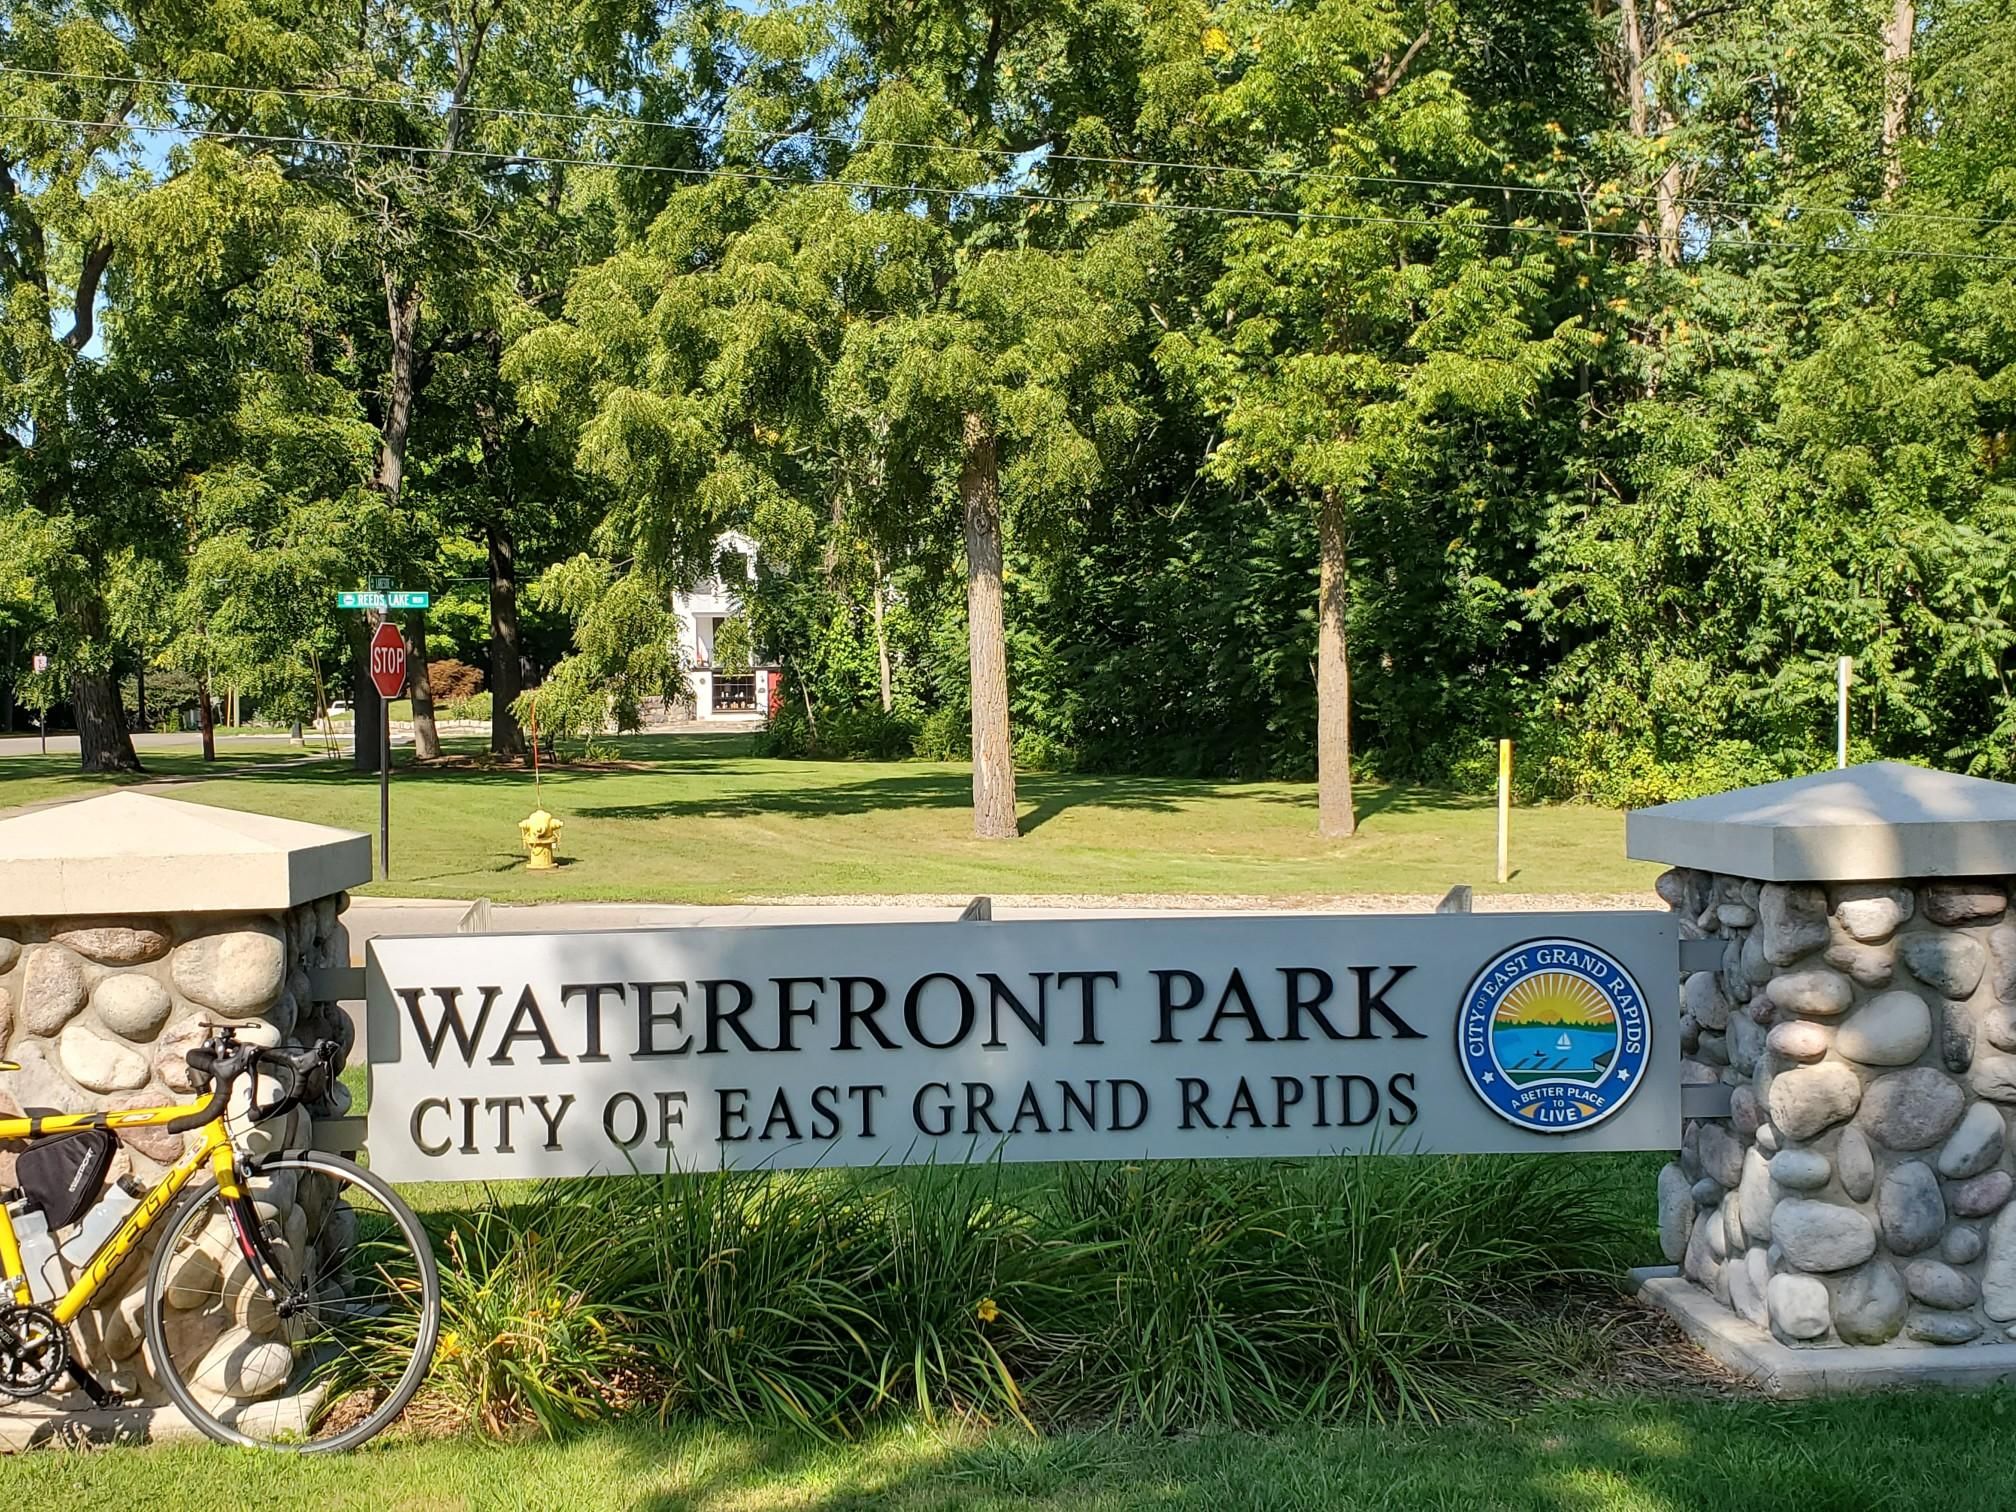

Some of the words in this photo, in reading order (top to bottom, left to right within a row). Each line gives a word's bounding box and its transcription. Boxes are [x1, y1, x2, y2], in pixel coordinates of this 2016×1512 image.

[358, 594, 385, 607] REEDS
[388, 594, 408, 607] LAKE
[373, 647, 404, 674] STOP
[1483, 955, 1529, 998] EAST
[1536, 949, 1608, 978] GRAND
[1476, 993, 1488, 1010] OF
[1606, 977, 1642, 1054] RAPIDS
[394, 970, 1119, 1068] WATERFRONT
[1148, 965, 1429, 1044] PARK
[1468, 1009, 1486, 1057] CITY
[1511, 1099, 1521, 1109] A
[1520, 1087, 1564, 1103] BETTER
[1567, 1087, 1605, 1107] PLACE
[1552, 1099, 1565, 1107] TO
[410, 1094, 576, 1158] CITY
[602, 1091, 689, 1150] OF
[714, 1085, 885, 1143] EAST
[912, 1079, 1149, 1136] GRAND
[1176, 1073, 1418, 1130] RAPIDS
[1540, 1108, 1578, 1122] LIVE
